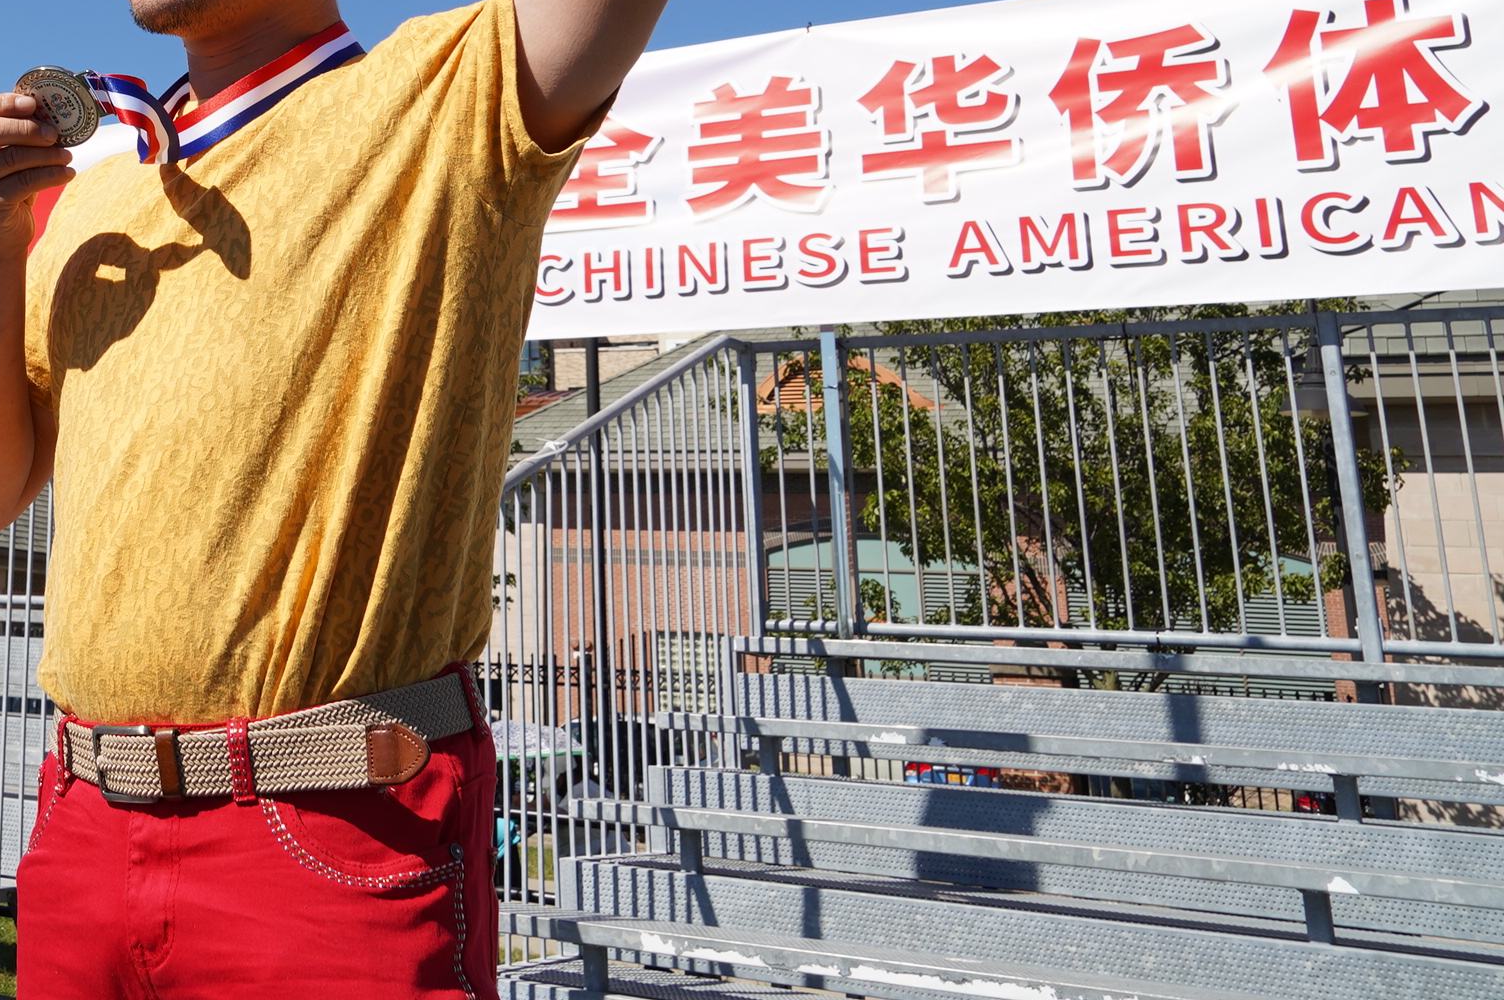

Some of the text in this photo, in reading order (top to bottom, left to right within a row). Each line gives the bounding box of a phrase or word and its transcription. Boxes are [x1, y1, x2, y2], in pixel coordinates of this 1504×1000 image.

[64, 96, 76, 111] 2021
[535, 181, 1504, 301] CHINESE AMERICAN
